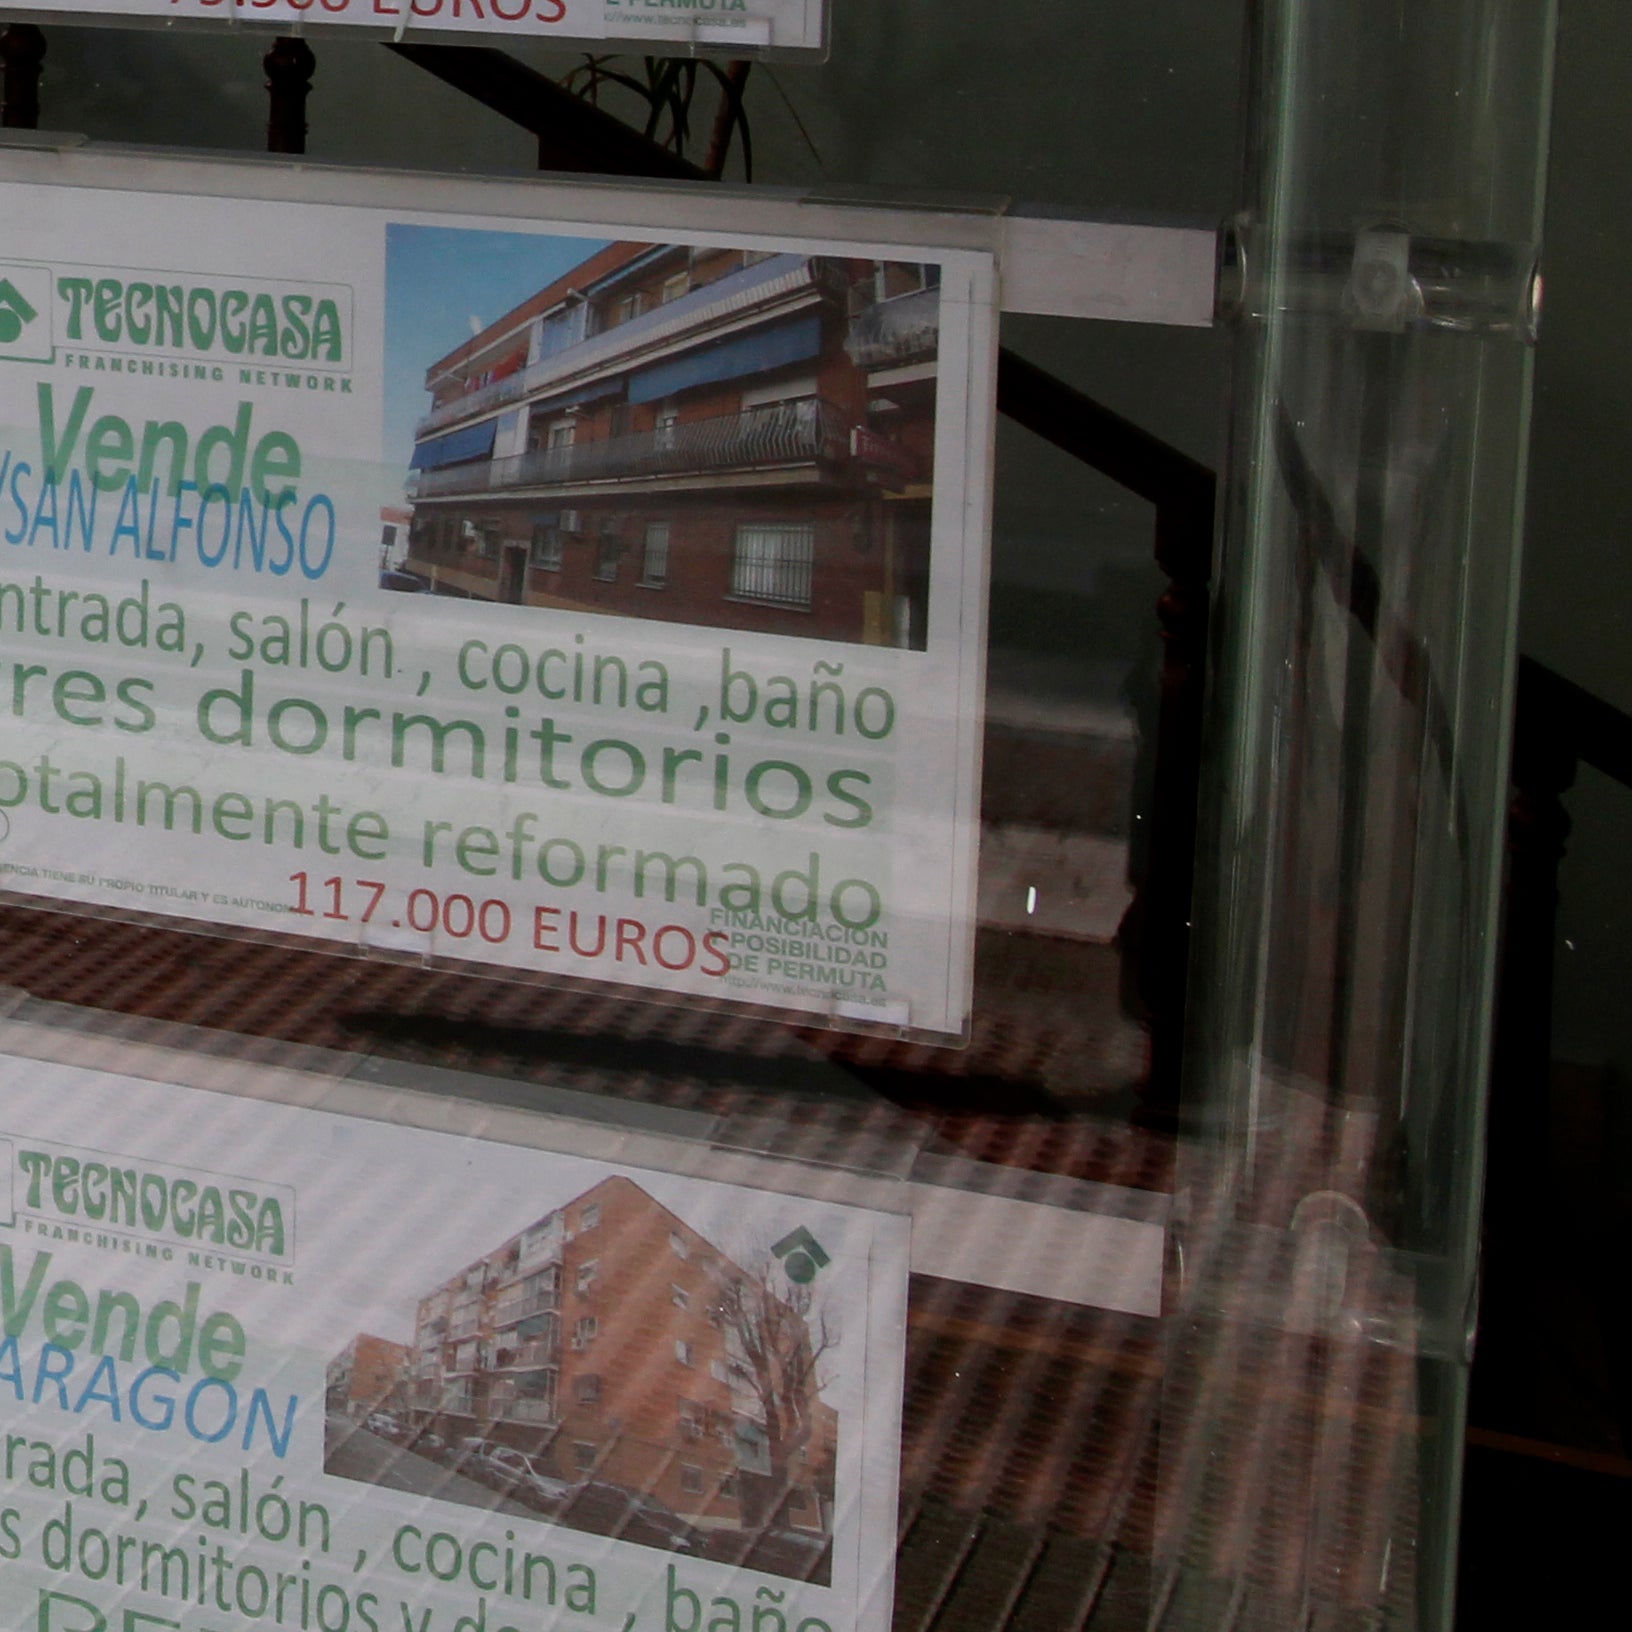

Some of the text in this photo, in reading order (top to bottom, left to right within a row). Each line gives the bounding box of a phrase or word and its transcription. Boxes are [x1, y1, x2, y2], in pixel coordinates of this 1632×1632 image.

[58, 277, 342, 362] TECNOCASA
[65, 354, 353, 393] FRANCHISING NETWORK
[35, 382, 302, 510] Vende
[113, 474, 335, 580] ALFONSO
[228, 602, 393, 681] salón
[458, 633, 670, 712] cocina
[198, 671, 876, 829] dormitorios
[147, 884, 198, 900] TITULAR
[288, 870, 731, 977] 117.000 EUROS
[423, 814, 882, 932] reformado
[710, 908, 888, 949] FINANCIACION
[730, 932, 887, 969] POSIBILIDAD
[767, 958, 886, 992] PERMUTA
[42, 1508, 379, 1632] dormitorios
[171, 1463, 330, 1550] salón
[393, 1522, 597, 1615] cocina
